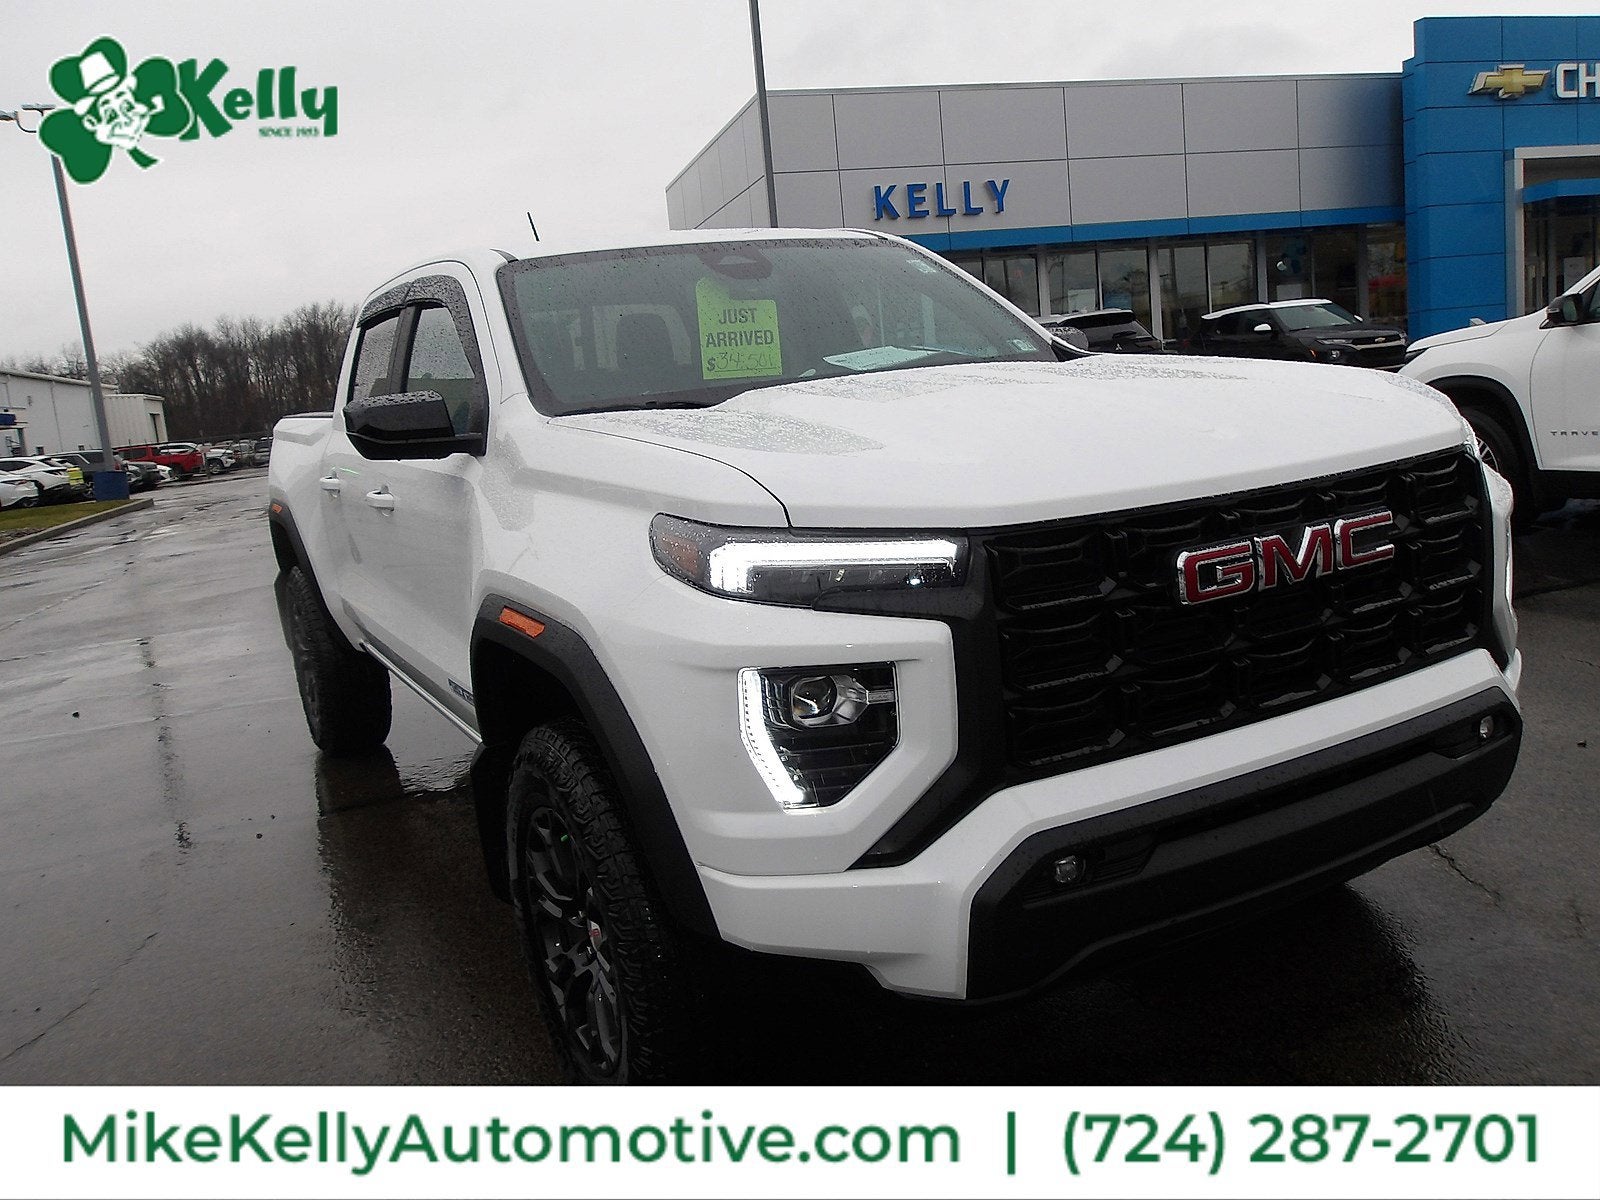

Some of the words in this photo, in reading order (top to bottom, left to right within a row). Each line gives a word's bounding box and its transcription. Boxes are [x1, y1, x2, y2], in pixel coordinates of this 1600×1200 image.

[1556, 63, 1600, 99] CH
[873, 179, 1010, 220] KELLY
[718, 308, 757, 324] JUST
[705, 329, 774, 347] ARRIVED
[1176, 511, 1395, 605] GMC
